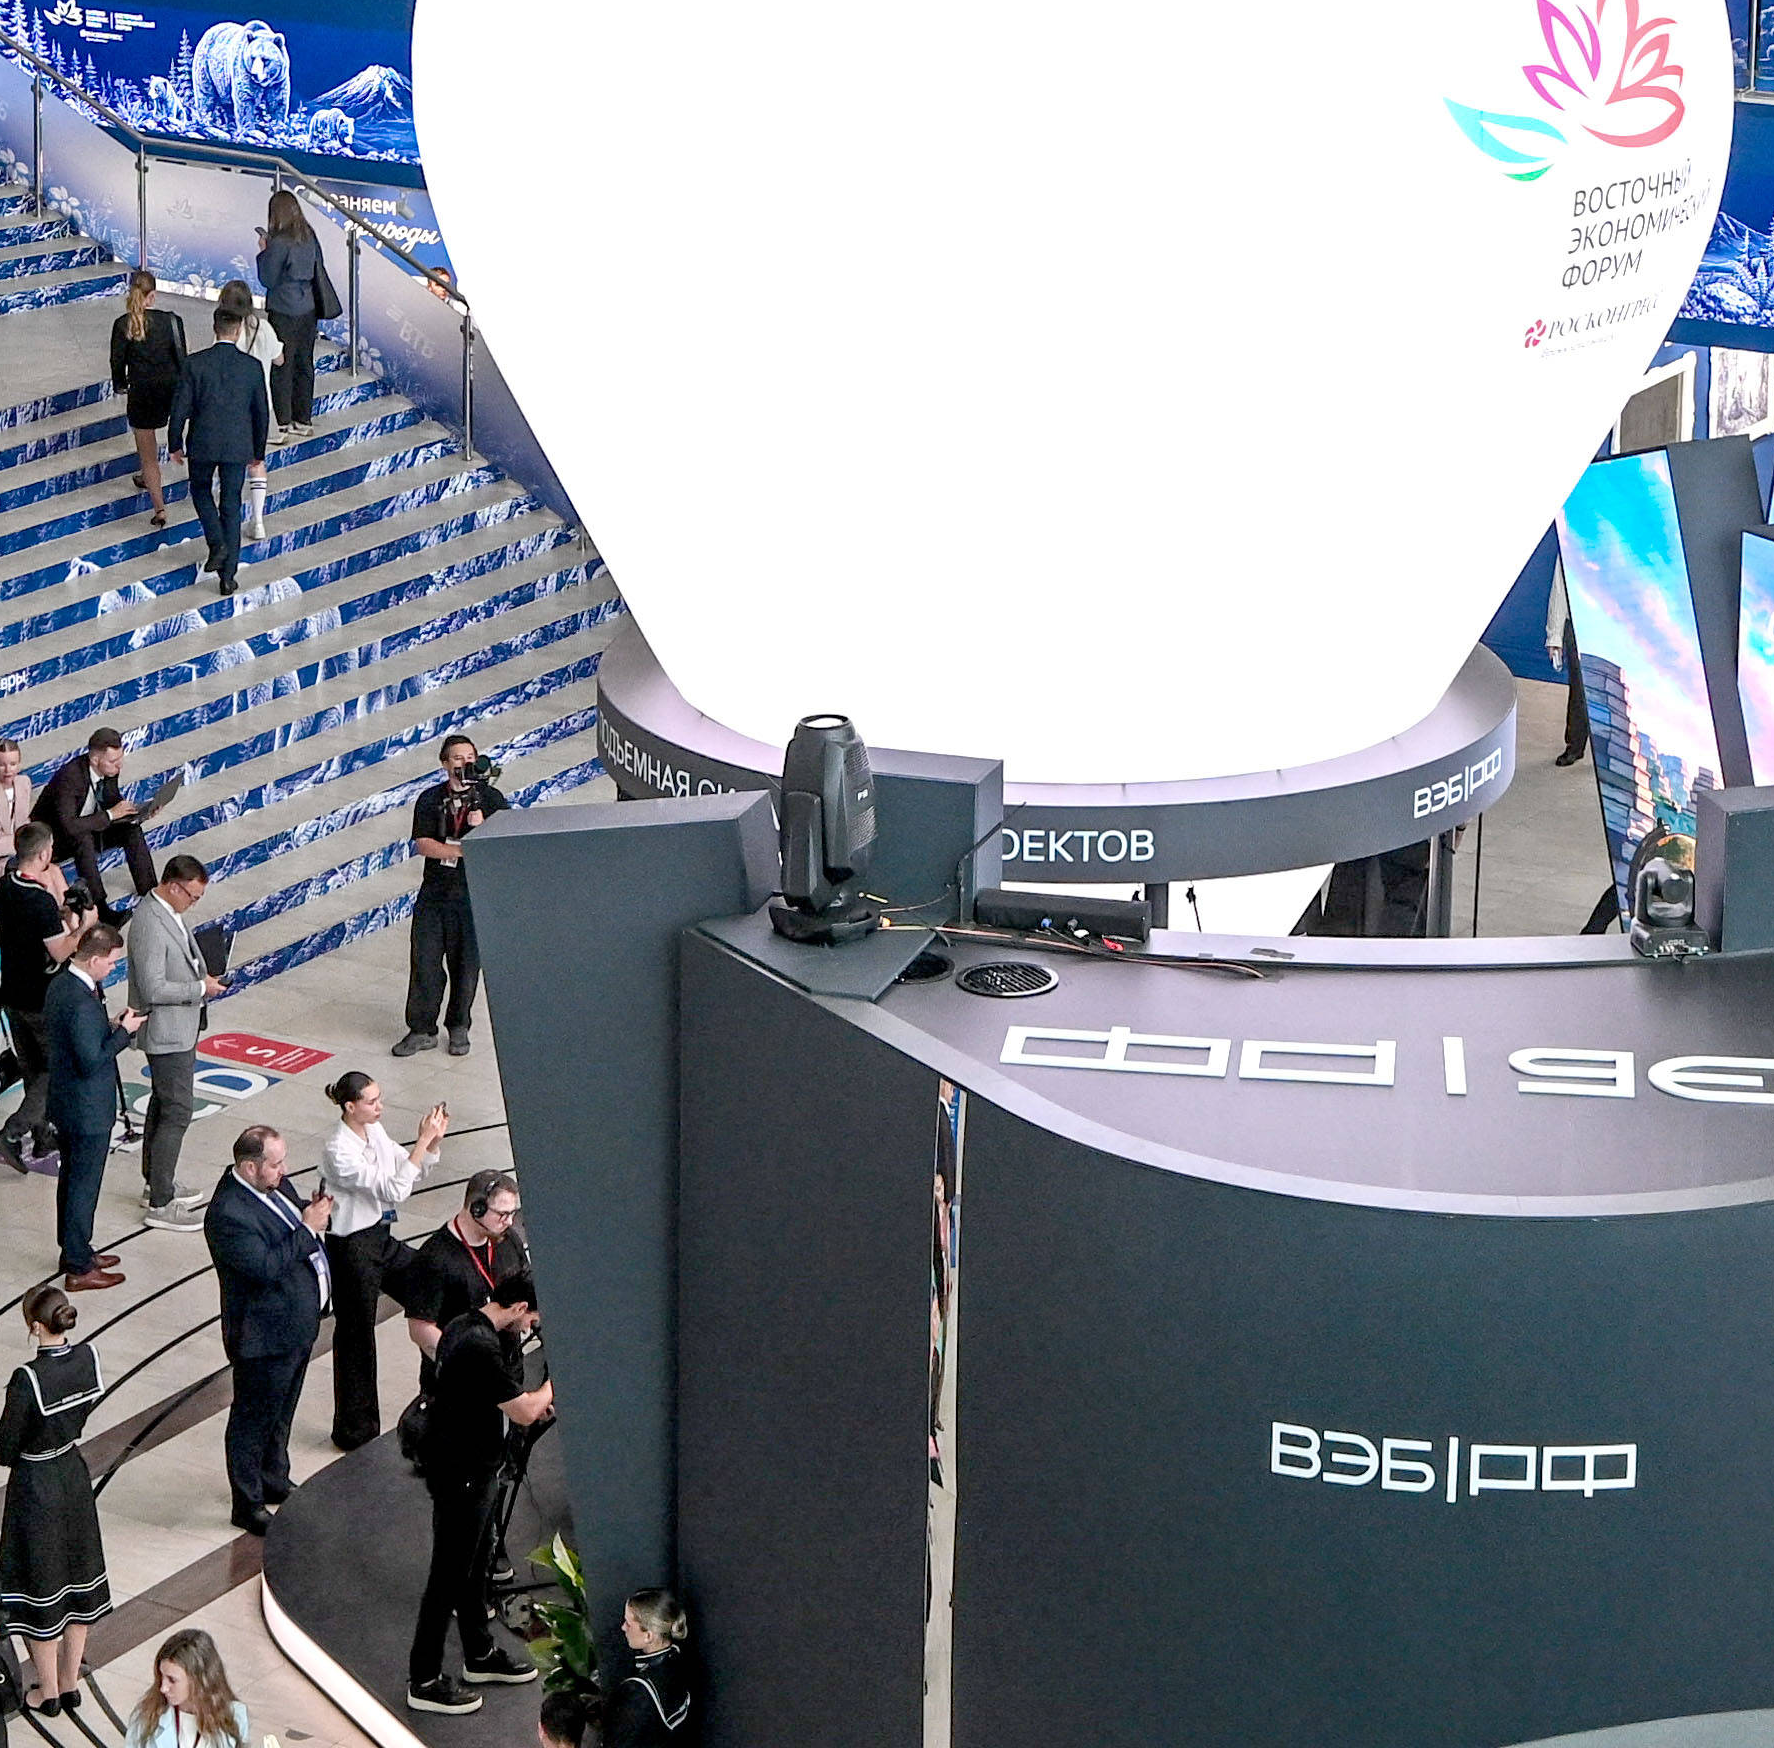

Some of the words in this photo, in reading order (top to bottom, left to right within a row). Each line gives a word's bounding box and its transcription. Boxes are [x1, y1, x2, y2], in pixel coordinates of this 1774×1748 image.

[1573, 158, 1692, 218] ВОСТОЧНЫЙ
[1562, 249, 1643, 290] ФОРУМ
[1002, 828, 1156, 863] ОЕКТОВ
[1271, 1420, 1638, 1504] ВЭБ|РФ
